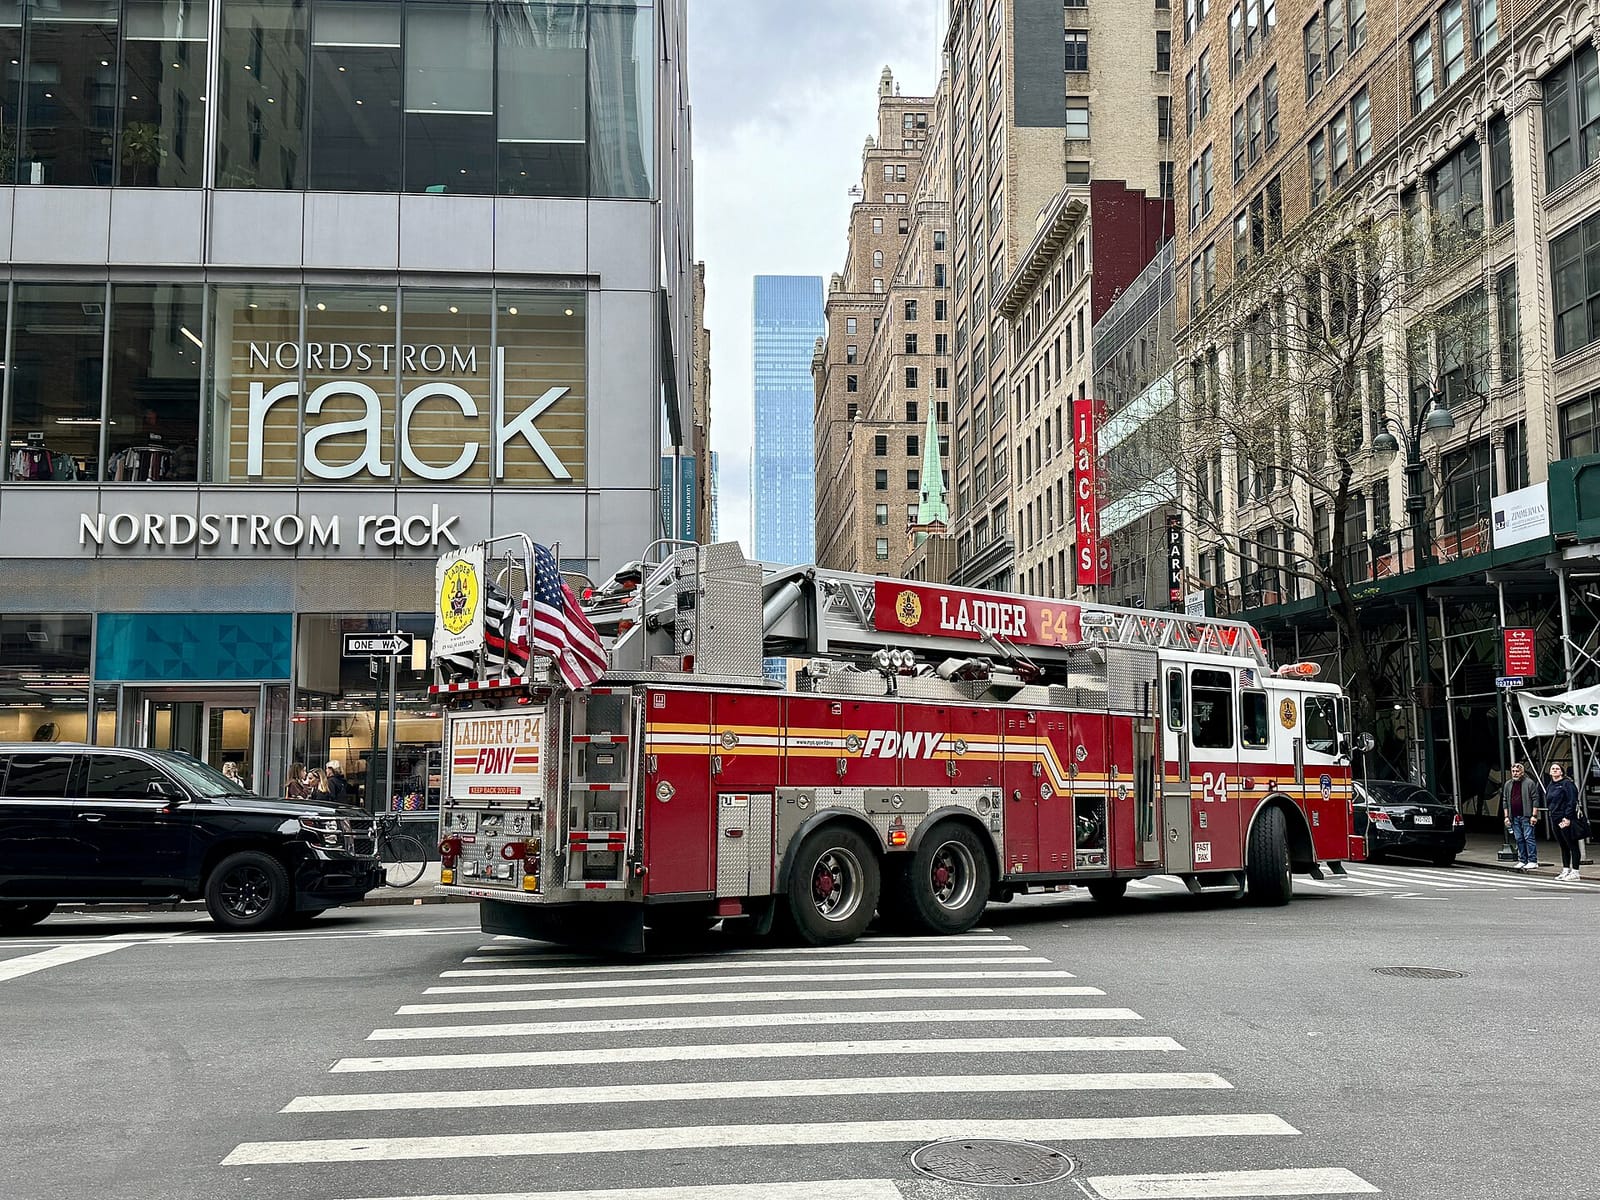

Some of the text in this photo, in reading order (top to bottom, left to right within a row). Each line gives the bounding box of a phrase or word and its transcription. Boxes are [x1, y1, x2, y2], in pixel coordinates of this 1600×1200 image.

[249, 341, 478, 372] NORDSTROM
[247, 346, 573, 480] rack
[1079, 413, 1091, 570] jack's
[79, 503, 459, 547] NORDSTROM rack
[448, 564, 471, 581] LADDER
[1170, 533, 1181, 582] PARK
[940, 596, 1068, 641] LADDER 24
[354, 640, 402, 650] ONE WAY
[454, 720, 503, 745] LADDER
[524, 718, 540, 743] 24
[862, 729, 944, 759] FDNY
[476, 747, 515, 774] FDNY
[1203, 772, 1227, 802] 24
[1196, 843, 1209, 852] FAST
[1197, 853, 1208, 861] PAK
